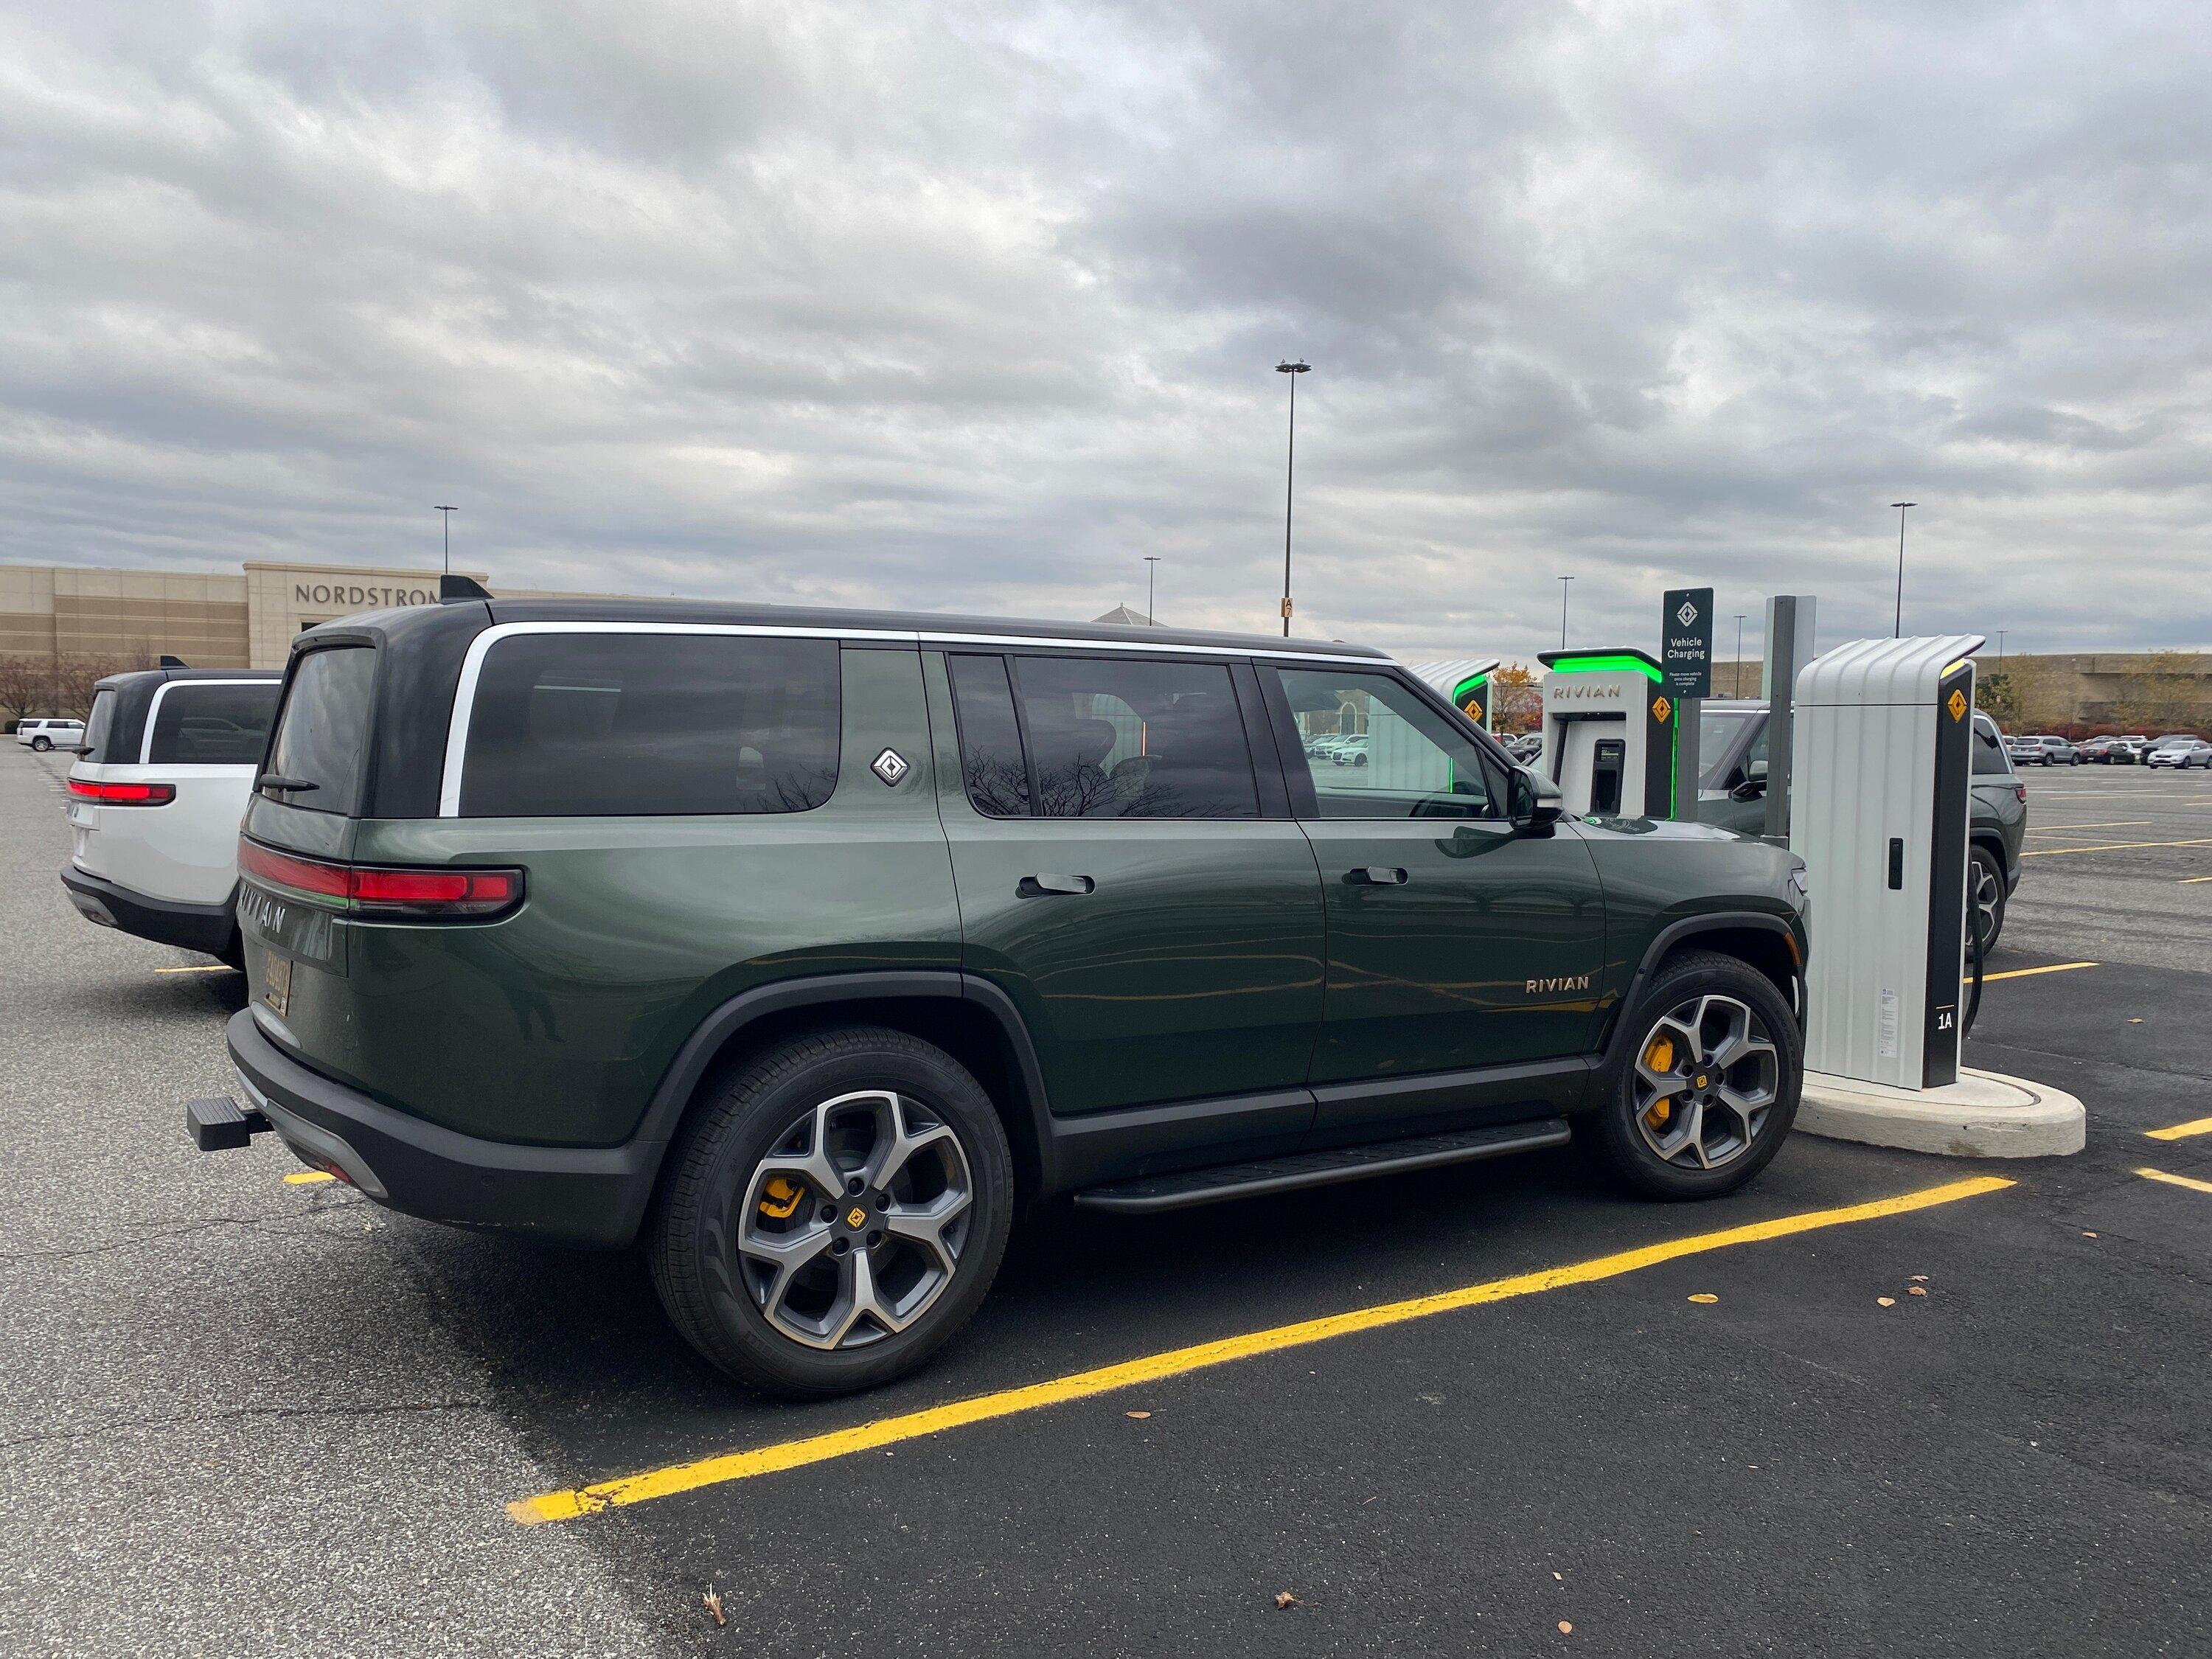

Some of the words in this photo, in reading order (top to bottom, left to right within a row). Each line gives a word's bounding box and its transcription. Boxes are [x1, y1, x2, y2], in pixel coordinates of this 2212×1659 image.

[1285, 599, 1293, 608] A
[1670, 636, 1703, 647] Vehicle
[1667, 648, 1705, 660] Charging
[1553, 684, 1621, 699] RIVIAN
[1526, 976, 1589, 994] RIVIAN
[1938, 1012, 1952, 1030] 1A
